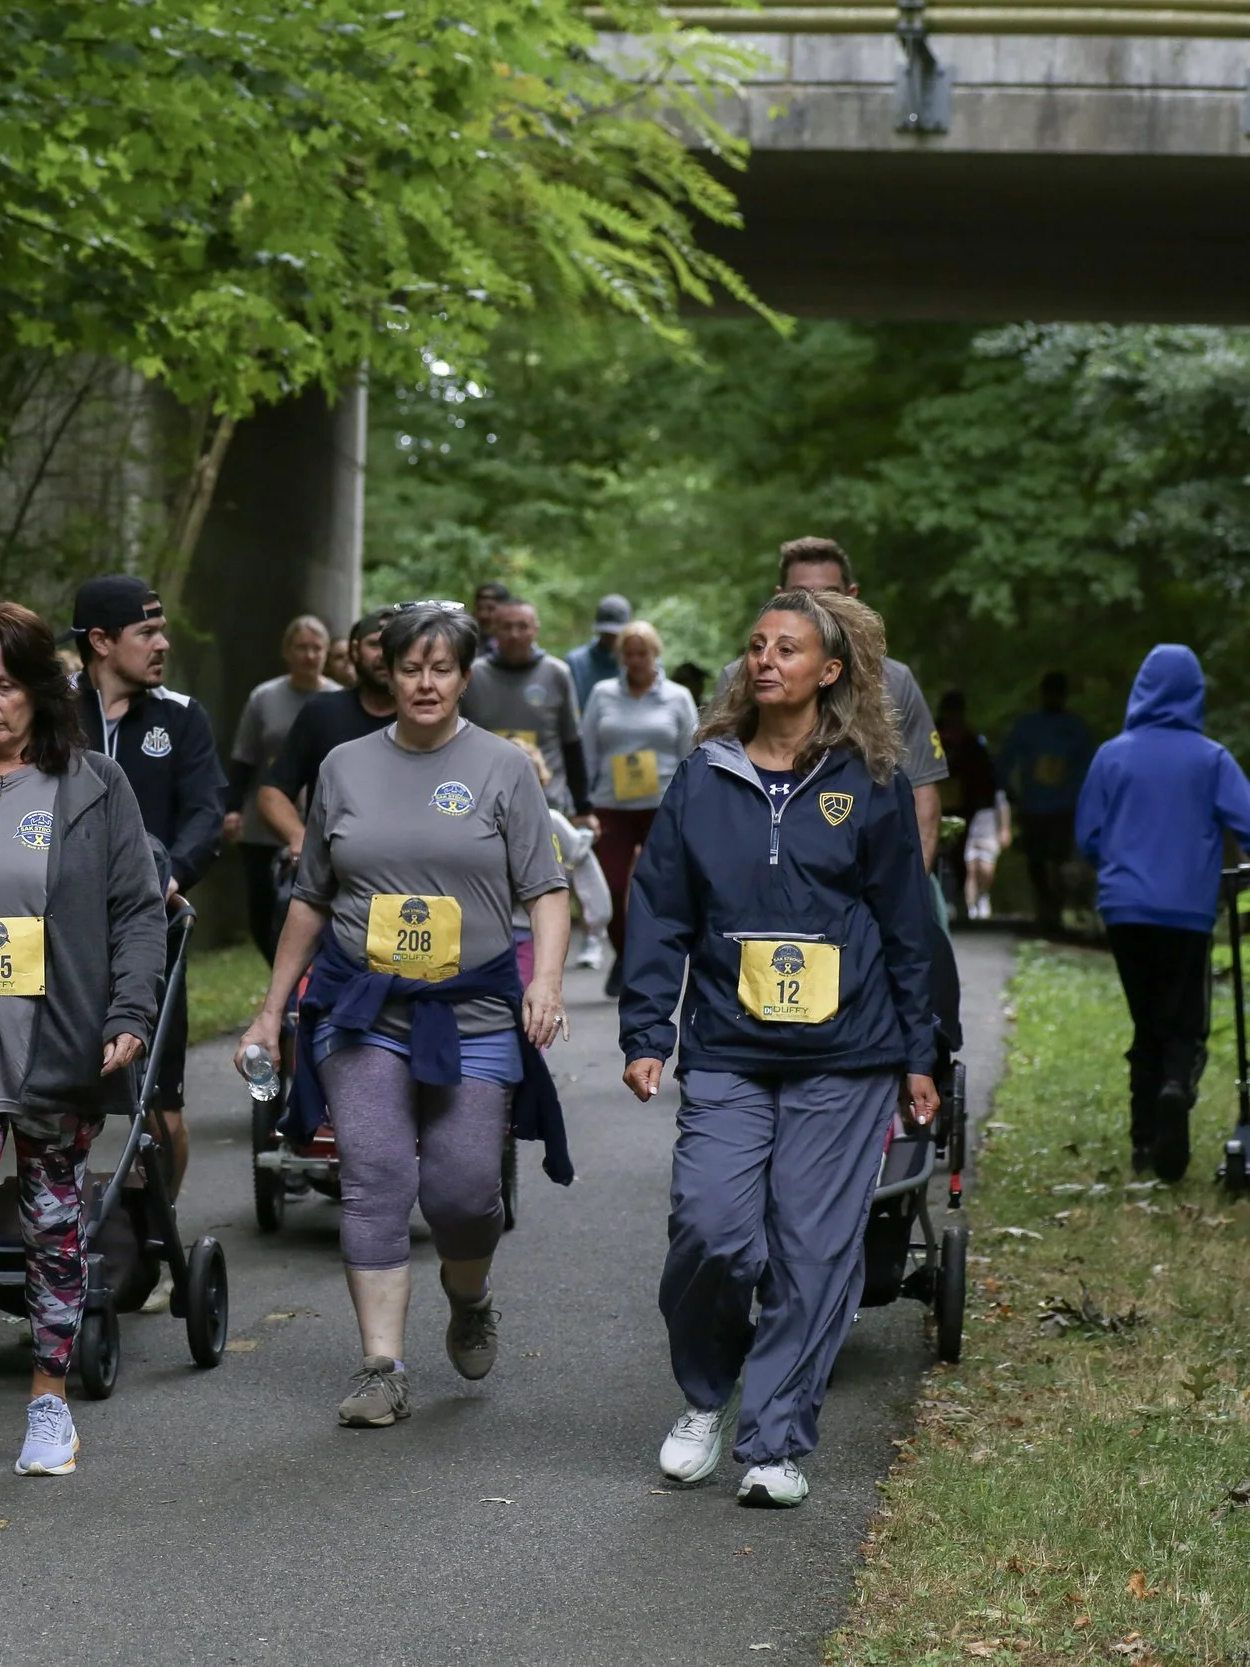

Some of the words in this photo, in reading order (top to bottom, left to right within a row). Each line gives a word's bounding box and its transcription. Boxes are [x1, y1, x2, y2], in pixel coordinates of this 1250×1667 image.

[397, 929, 431, 952] 208
[777, 980, 800, 1004] 12
[772, 1005, 809, 1014] DUFFY
